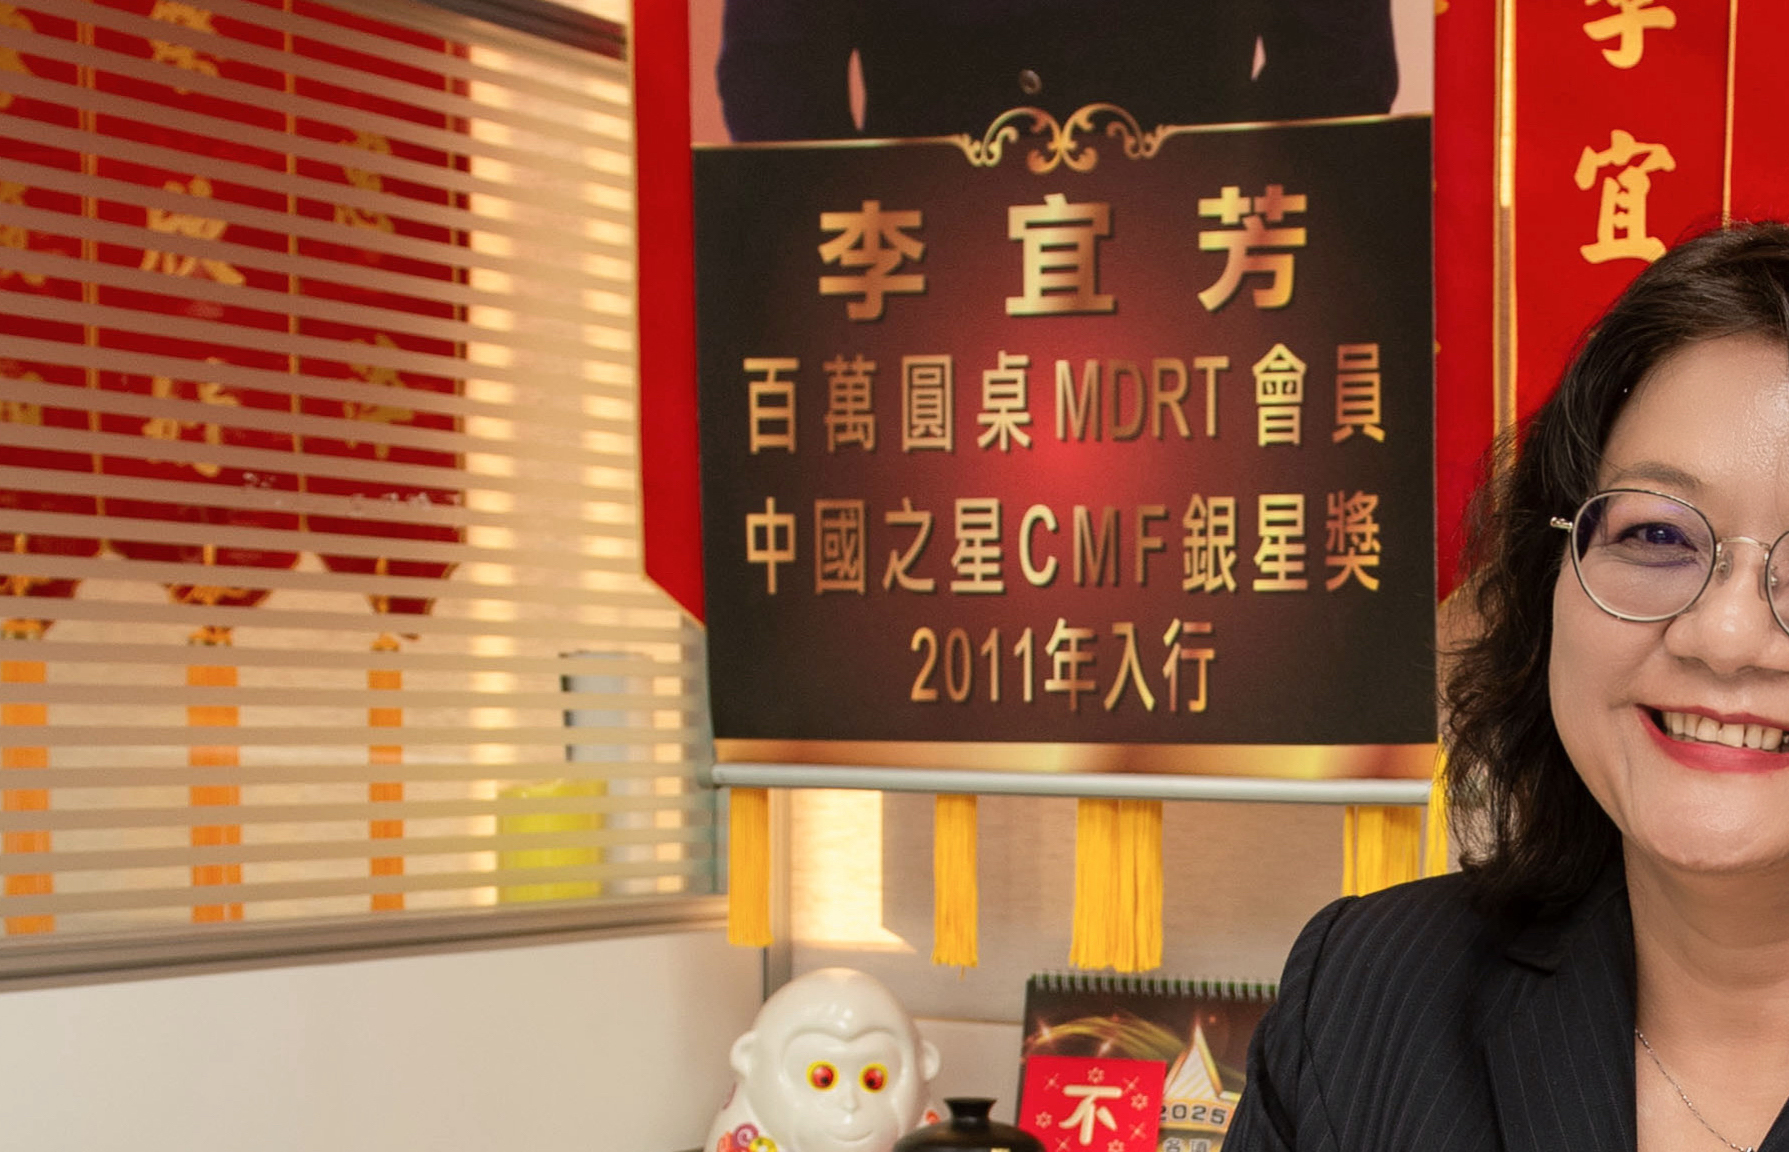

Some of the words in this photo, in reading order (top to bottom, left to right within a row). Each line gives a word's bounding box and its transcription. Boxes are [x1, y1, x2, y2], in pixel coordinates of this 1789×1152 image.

[817, 185, 1308, 320] 李宜芳
[743, 342, 1386, 454] 百萬圓桌MDRT會員
[744, 490, 1382, 595] 中國之星CMF銀星獎
[910, 618, 1217, 713] 2011年入行
